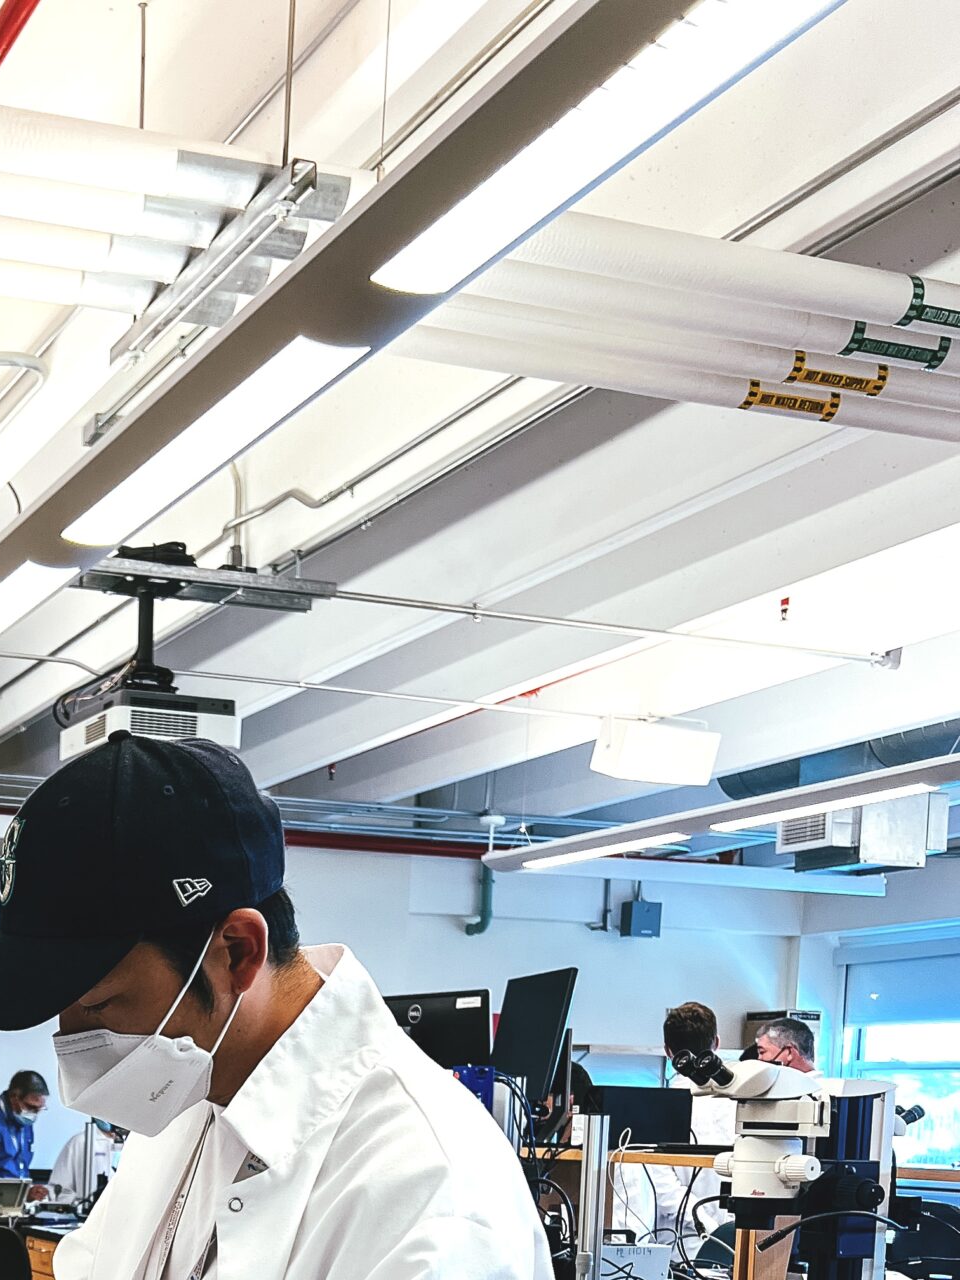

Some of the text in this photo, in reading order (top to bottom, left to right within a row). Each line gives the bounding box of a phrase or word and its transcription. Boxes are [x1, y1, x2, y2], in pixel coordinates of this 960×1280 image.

[805, 370, 871, 391] HOT WATER SUPPLY
[760, 393, 825, 412] HOT WATER RETURN
